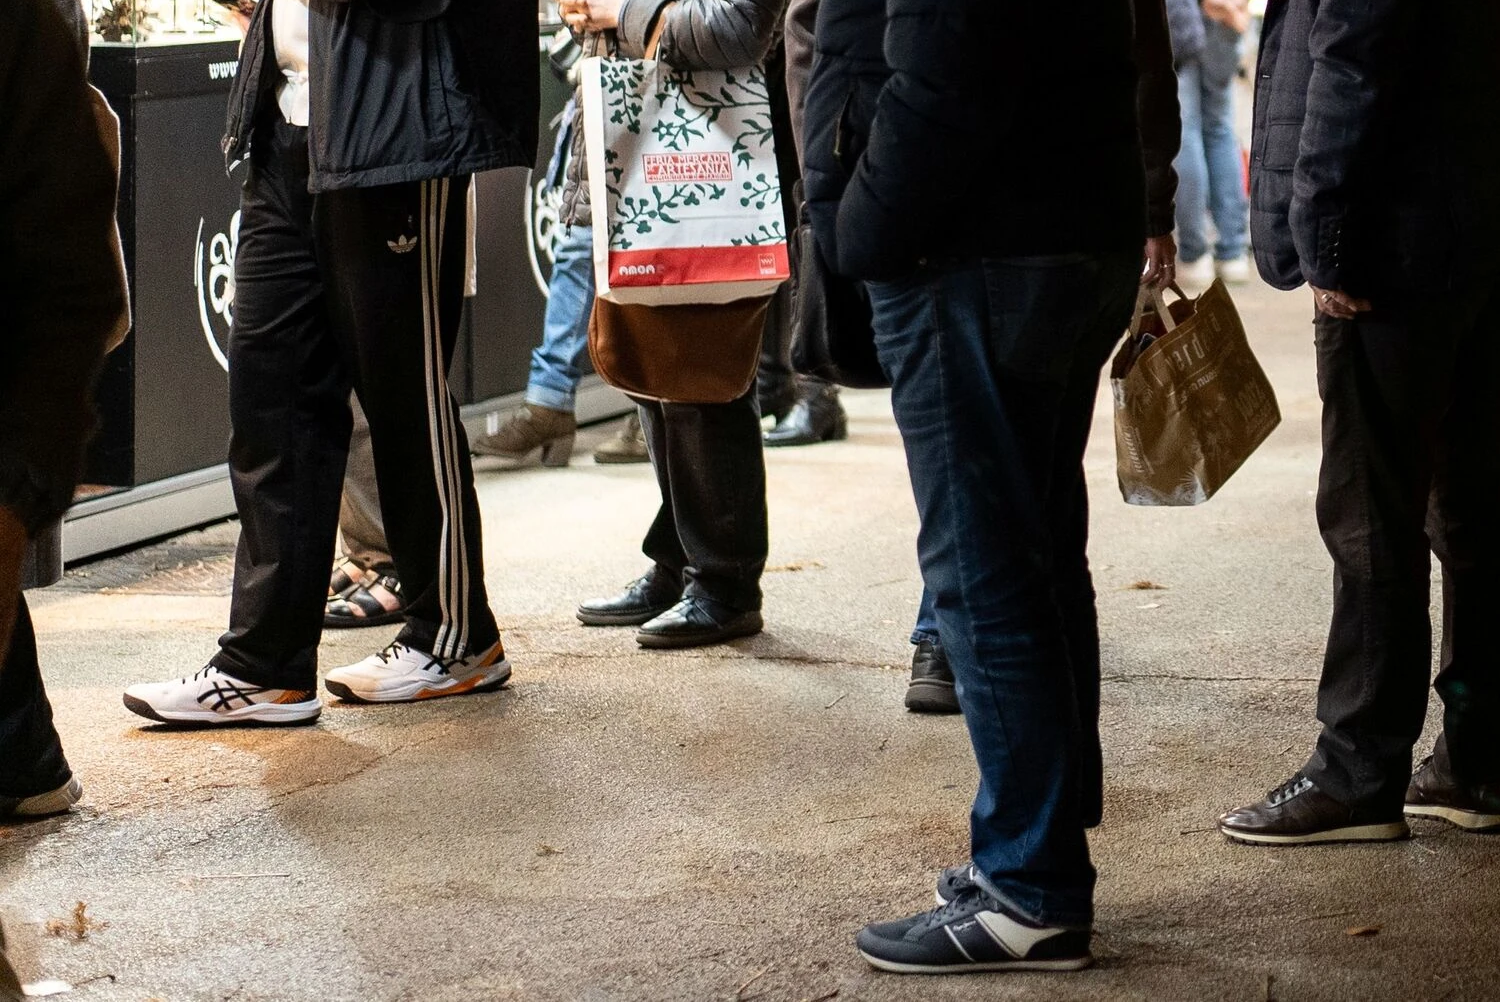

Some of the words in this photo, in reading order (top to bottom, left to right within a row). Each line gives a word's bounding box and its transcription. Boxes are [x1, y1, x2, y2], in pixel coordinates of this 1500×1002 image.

[645, 155, 674, 165] FERIA
[677, 153, 728, 164] MERCADO
[619, 264, 655, 275] AMOA
